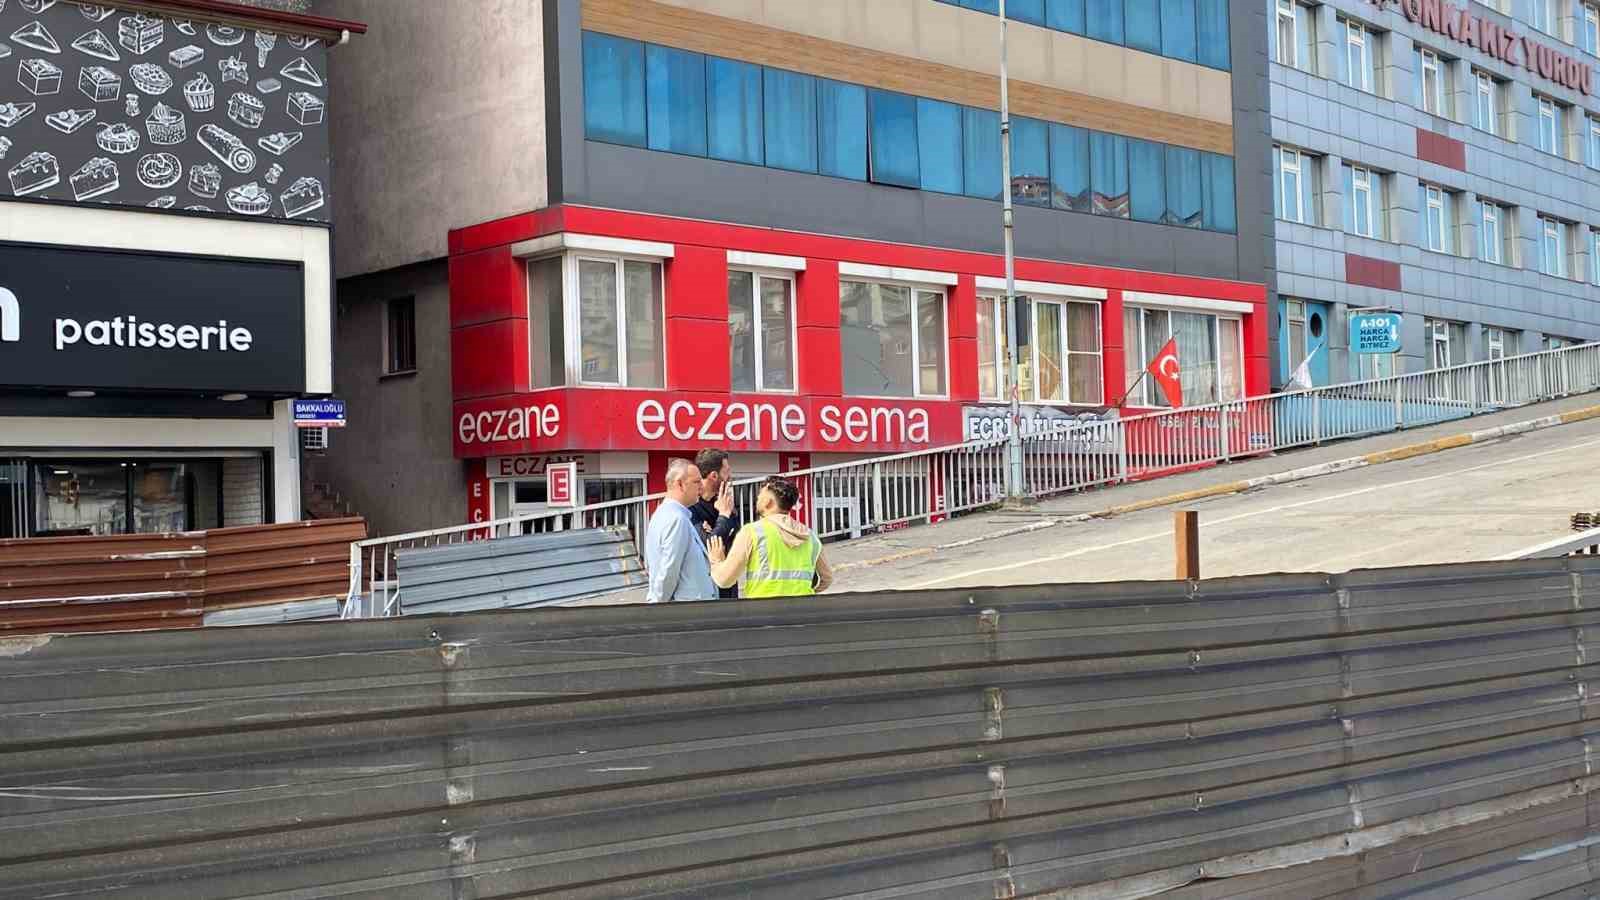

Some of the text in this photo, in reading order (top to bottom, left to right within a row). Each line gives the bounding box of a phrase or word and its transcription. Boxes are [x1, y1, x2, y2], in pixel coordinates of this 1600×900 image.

[1478, 16, 1517, 67] KIZ
[1521, 36, 1592, 96] YURDU
[55, 315, 253, 351] patisserie
[459, 403, 560, 444] eczane
[636, 399, 930, 443] eczane sema
